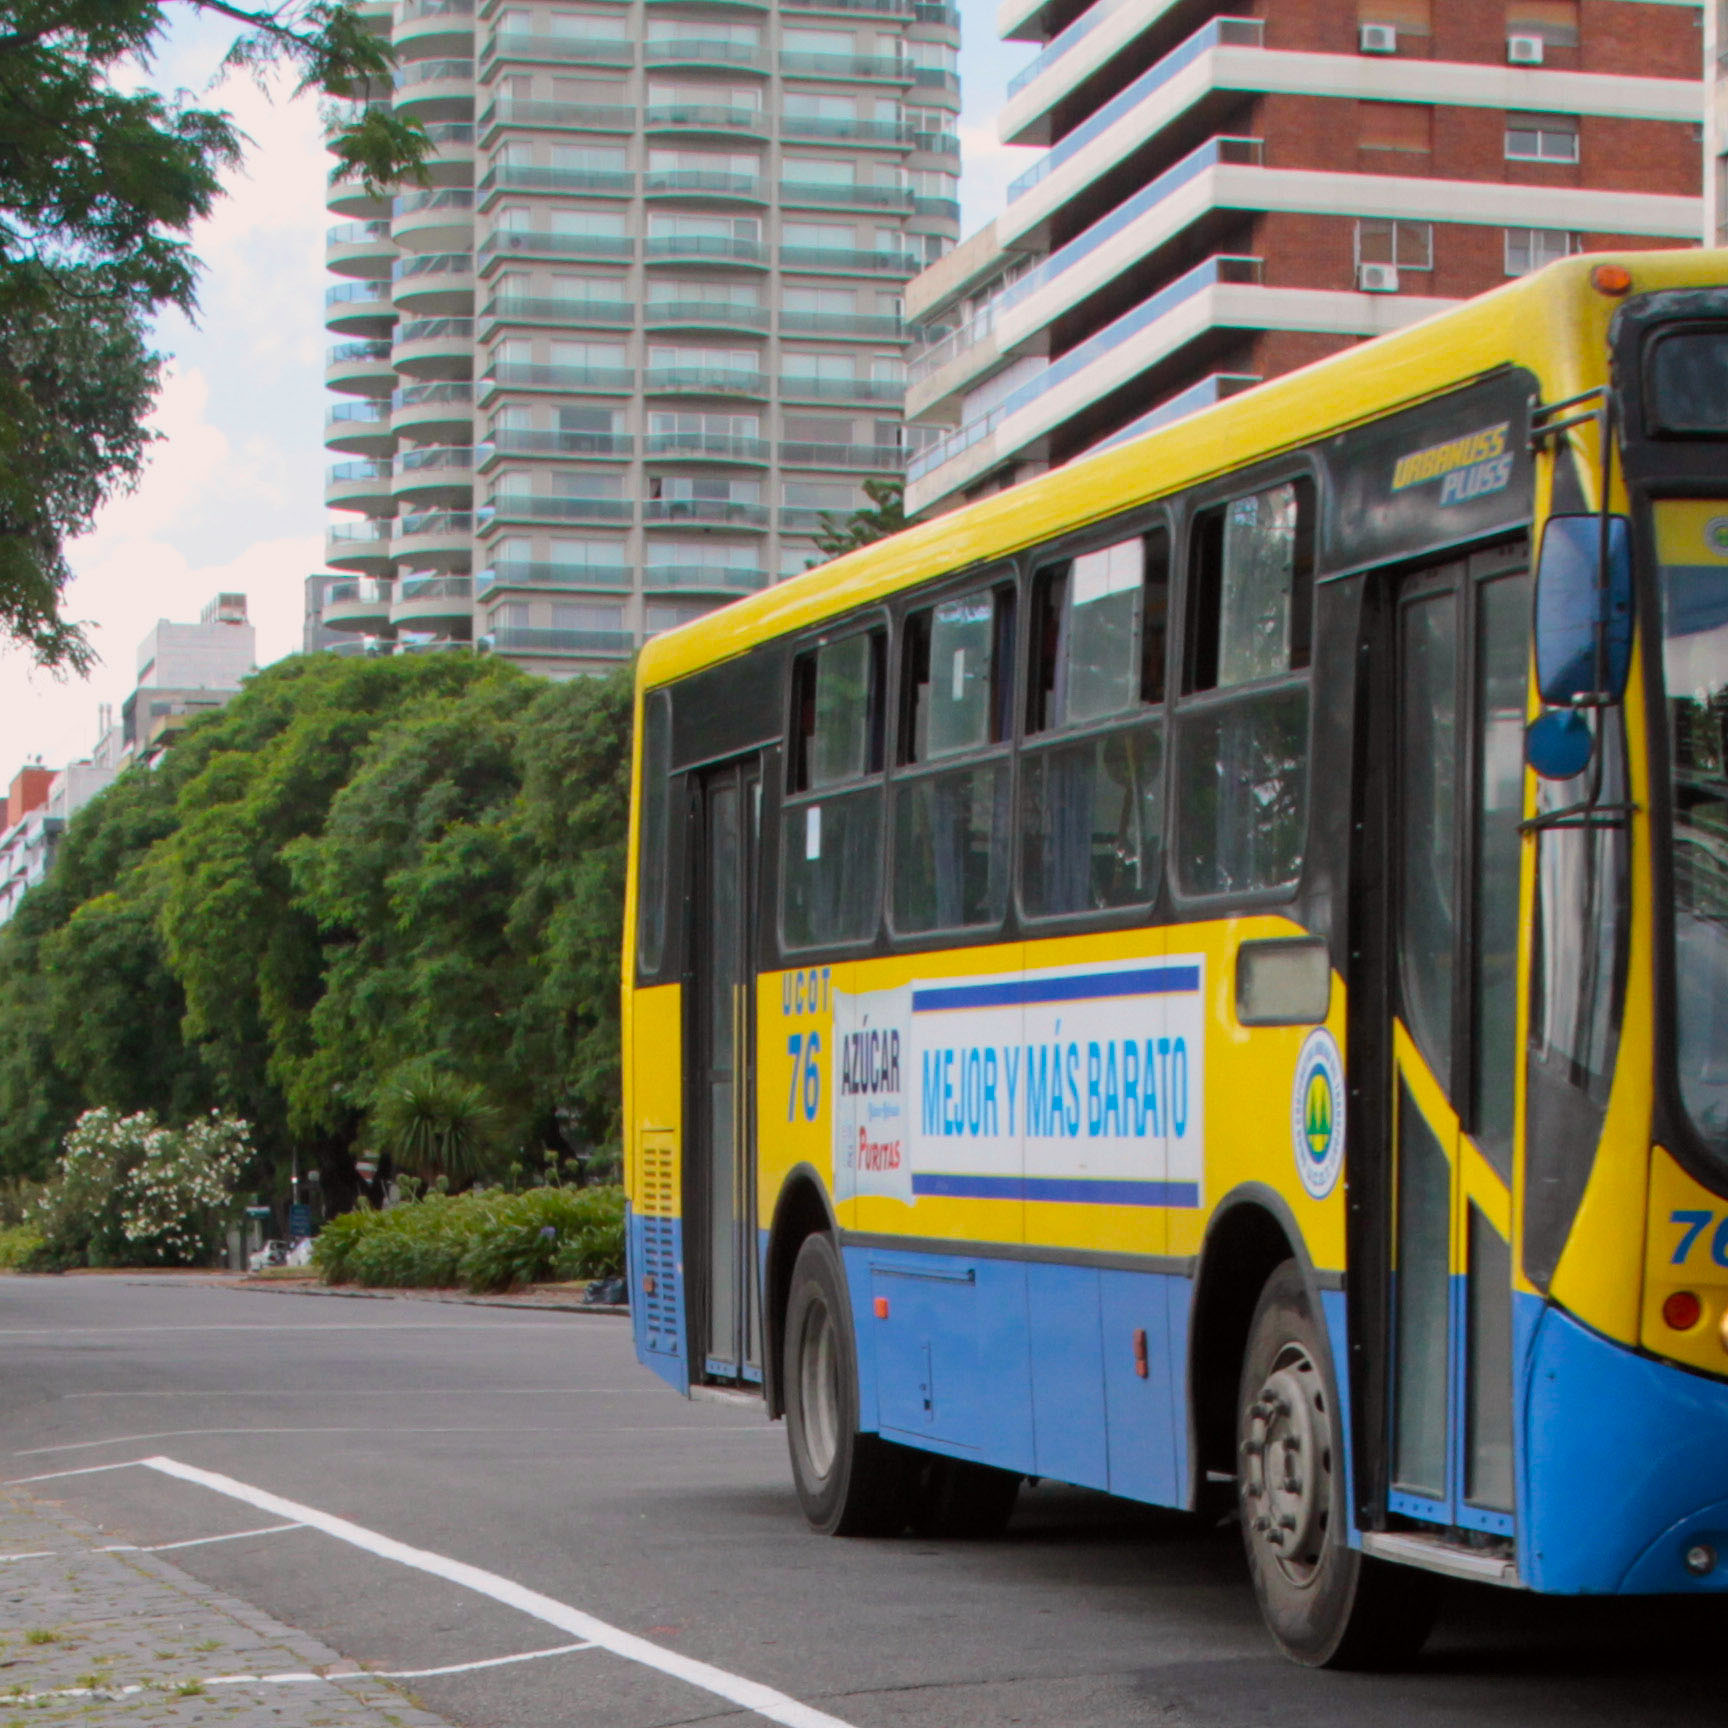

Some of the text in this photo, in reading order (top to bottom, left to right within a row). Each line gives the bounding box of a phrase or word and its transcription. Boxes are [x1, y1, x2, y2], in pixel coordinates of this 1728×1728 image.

[1439, 451, 1515, 507] PLUSS
[782, 967, 831, 1016] UCOT
[786, 1030, 822, 1123] 76
[841, 1014, 901, 1096] AZÚCAR
[922, 1046, 999, 1138] MEJOR
[1003, 1045, 1021, 1138] Y
[1026, 1017, 1081, 1139] MÁS
[1087, 1035, 1189, 1139] BARATO
